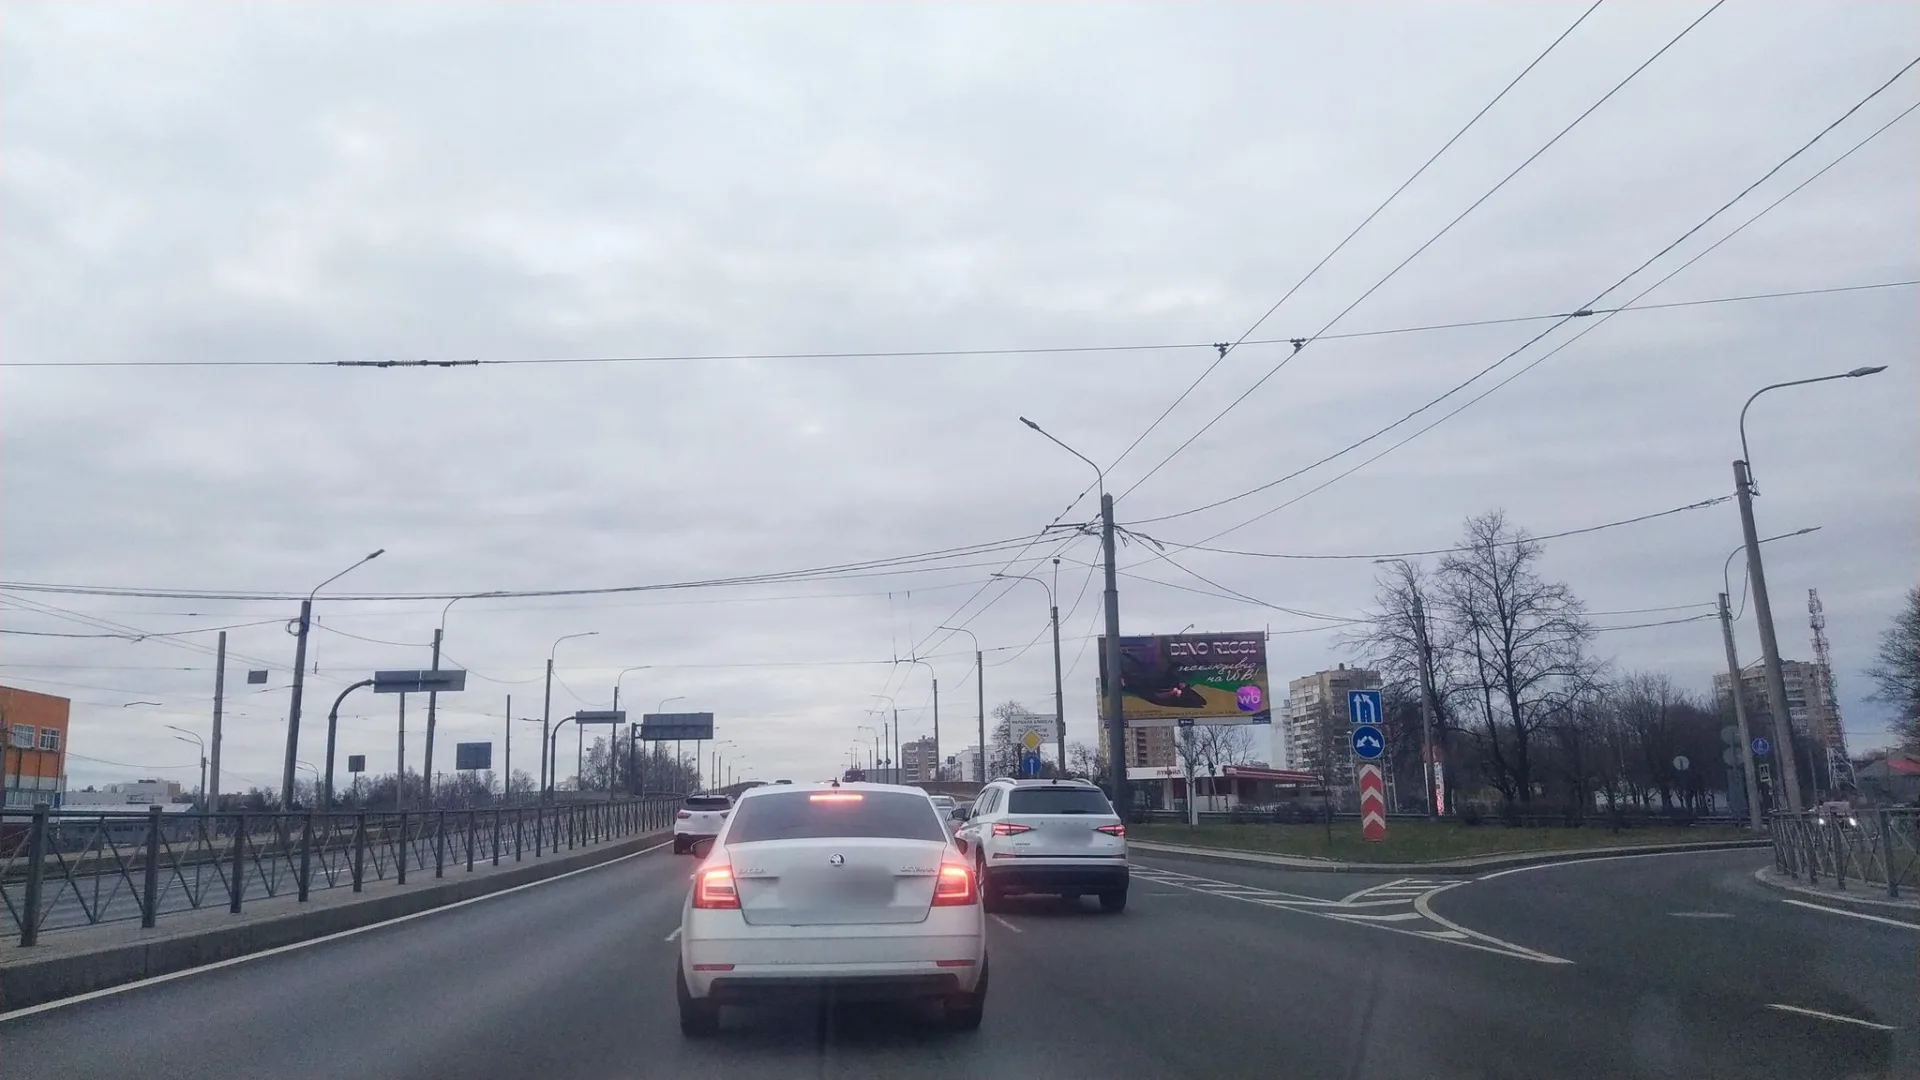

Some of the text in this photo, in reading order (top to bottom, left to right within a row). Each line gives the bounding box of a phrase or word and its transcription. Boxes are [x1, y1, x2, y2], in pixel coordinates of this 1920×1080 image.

[1170, 641, 1256, 656] DINO RICCI
[1206, 675, 1224, 683] на
